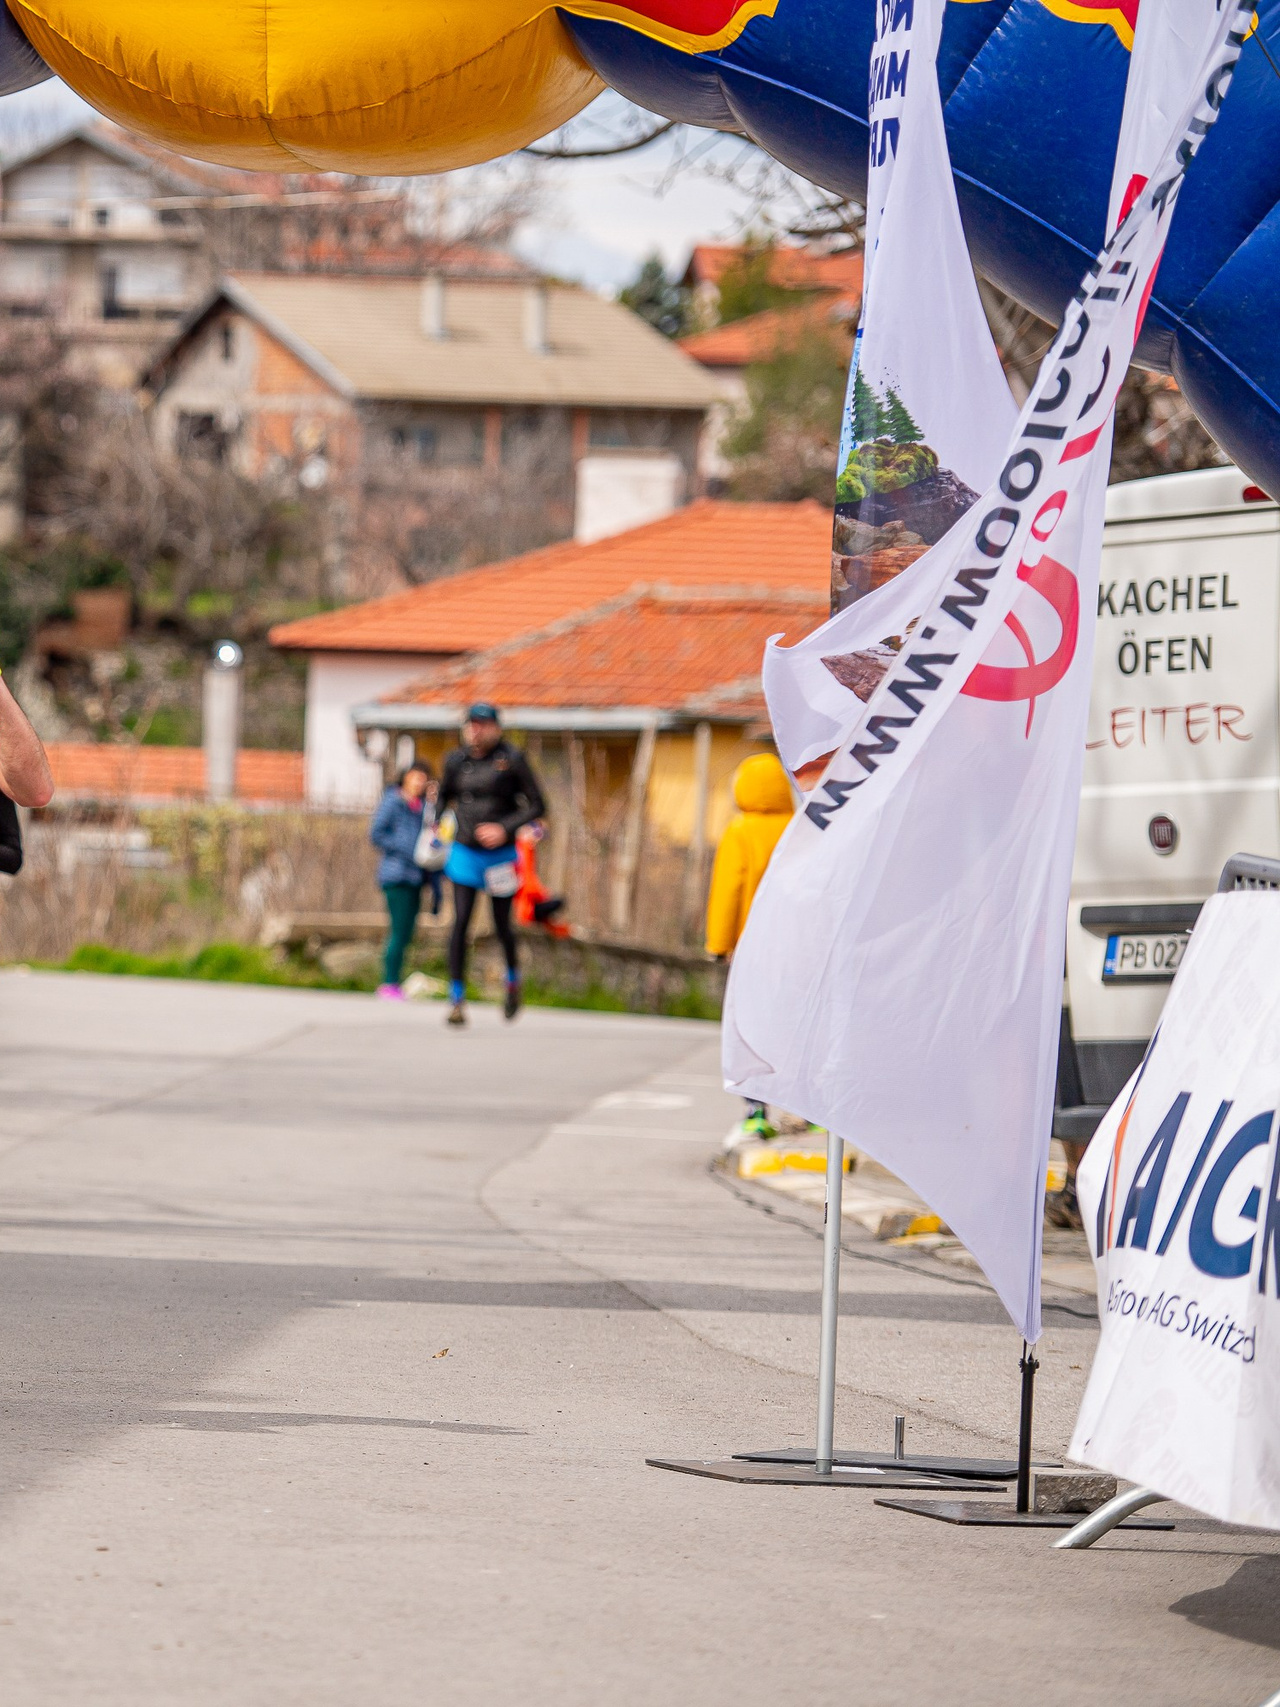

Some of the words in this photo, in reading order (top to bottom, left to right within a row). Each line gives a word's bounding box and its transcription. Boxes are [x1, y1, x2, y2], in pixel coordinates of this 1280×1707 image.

[1098, 573, 1239, 617] KACHEL
[1118, 630, 1214, 677] ÖFEN
[1119, 941, 1147, 968] PB
[1146, 1291, 1181, 1328] AG
